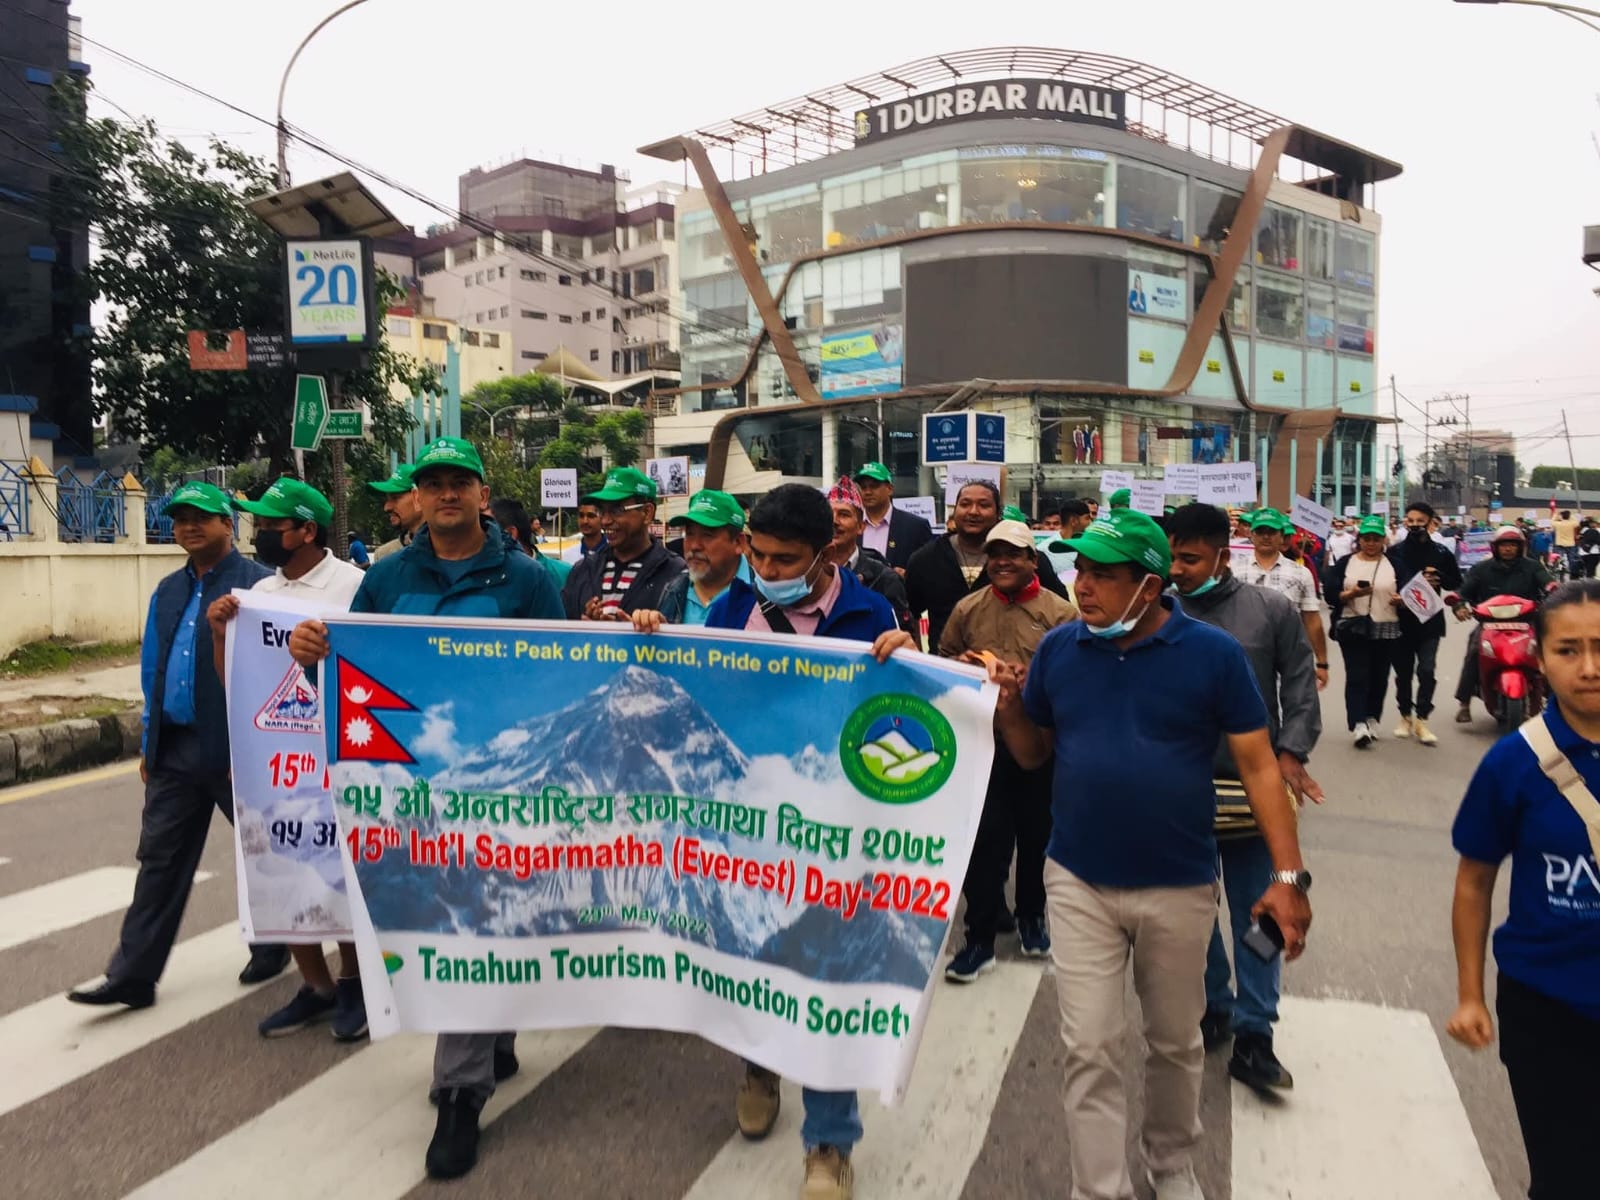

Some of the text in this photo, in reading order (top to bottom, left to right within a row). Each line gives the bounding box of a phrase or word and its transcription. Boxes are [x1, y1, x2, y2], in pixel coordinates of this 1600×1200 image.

[893, 83, 1028, 131] DURBAR
[1036, 83, 1118, 120] MALL
[313, 249, 356, 260] MetLife
[296, 263, 357, 306] 20
[299, 308, 357, 323] YEARS
[543, 478, 572, 487] Glorious
[545, 491, 572, 499] Everest
[428, 637, 866, 683] "Everst: Peak of the World, Pride of Nepal"
[265, 720, 289, 728] NARA
[269, 752, 316, 788] 15th
[271, 820, 303, 848] १५
[343, 785, 382, 818] १५
[626, 792, 768, 840] सगरमाथा
[776, 802, 853, 861] दिवस
[861, 827, 946, 865] २०७९
[346, 826, 951, 922] 15th Int'l Sagarmatha (Everest) Day-2022
[418, 945, 541, 985] Tanahun
[550, 944, 666, 980] Tourism
[674, 951, 799, 1025] Promotion
